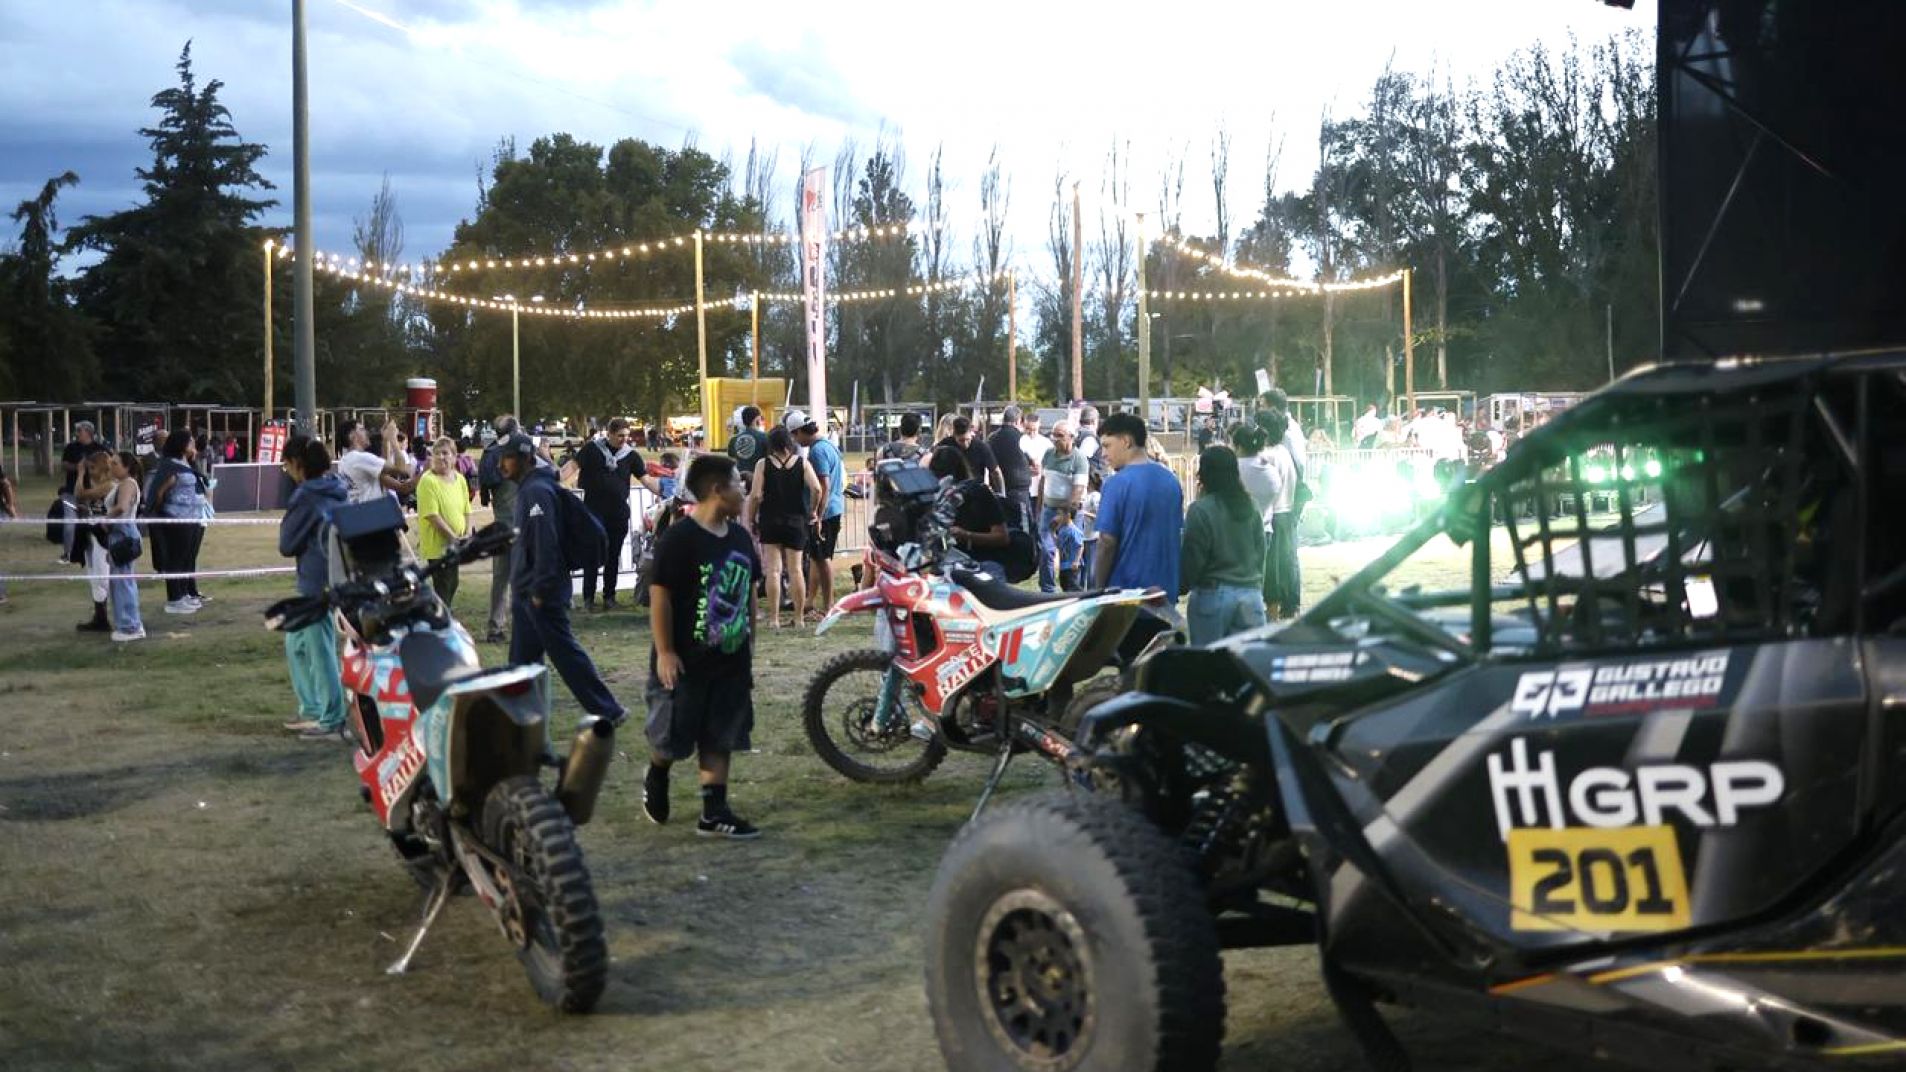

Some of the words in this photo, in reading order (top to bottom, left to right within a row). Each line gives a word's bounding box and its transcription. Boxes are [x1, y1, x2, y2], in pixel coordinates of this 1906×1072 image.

[1594, 655, 1730, 684] GUSTAVO
[1588, 675, 1725, 704] GALLEGO
[1531, 846, 1674, 917] 201
